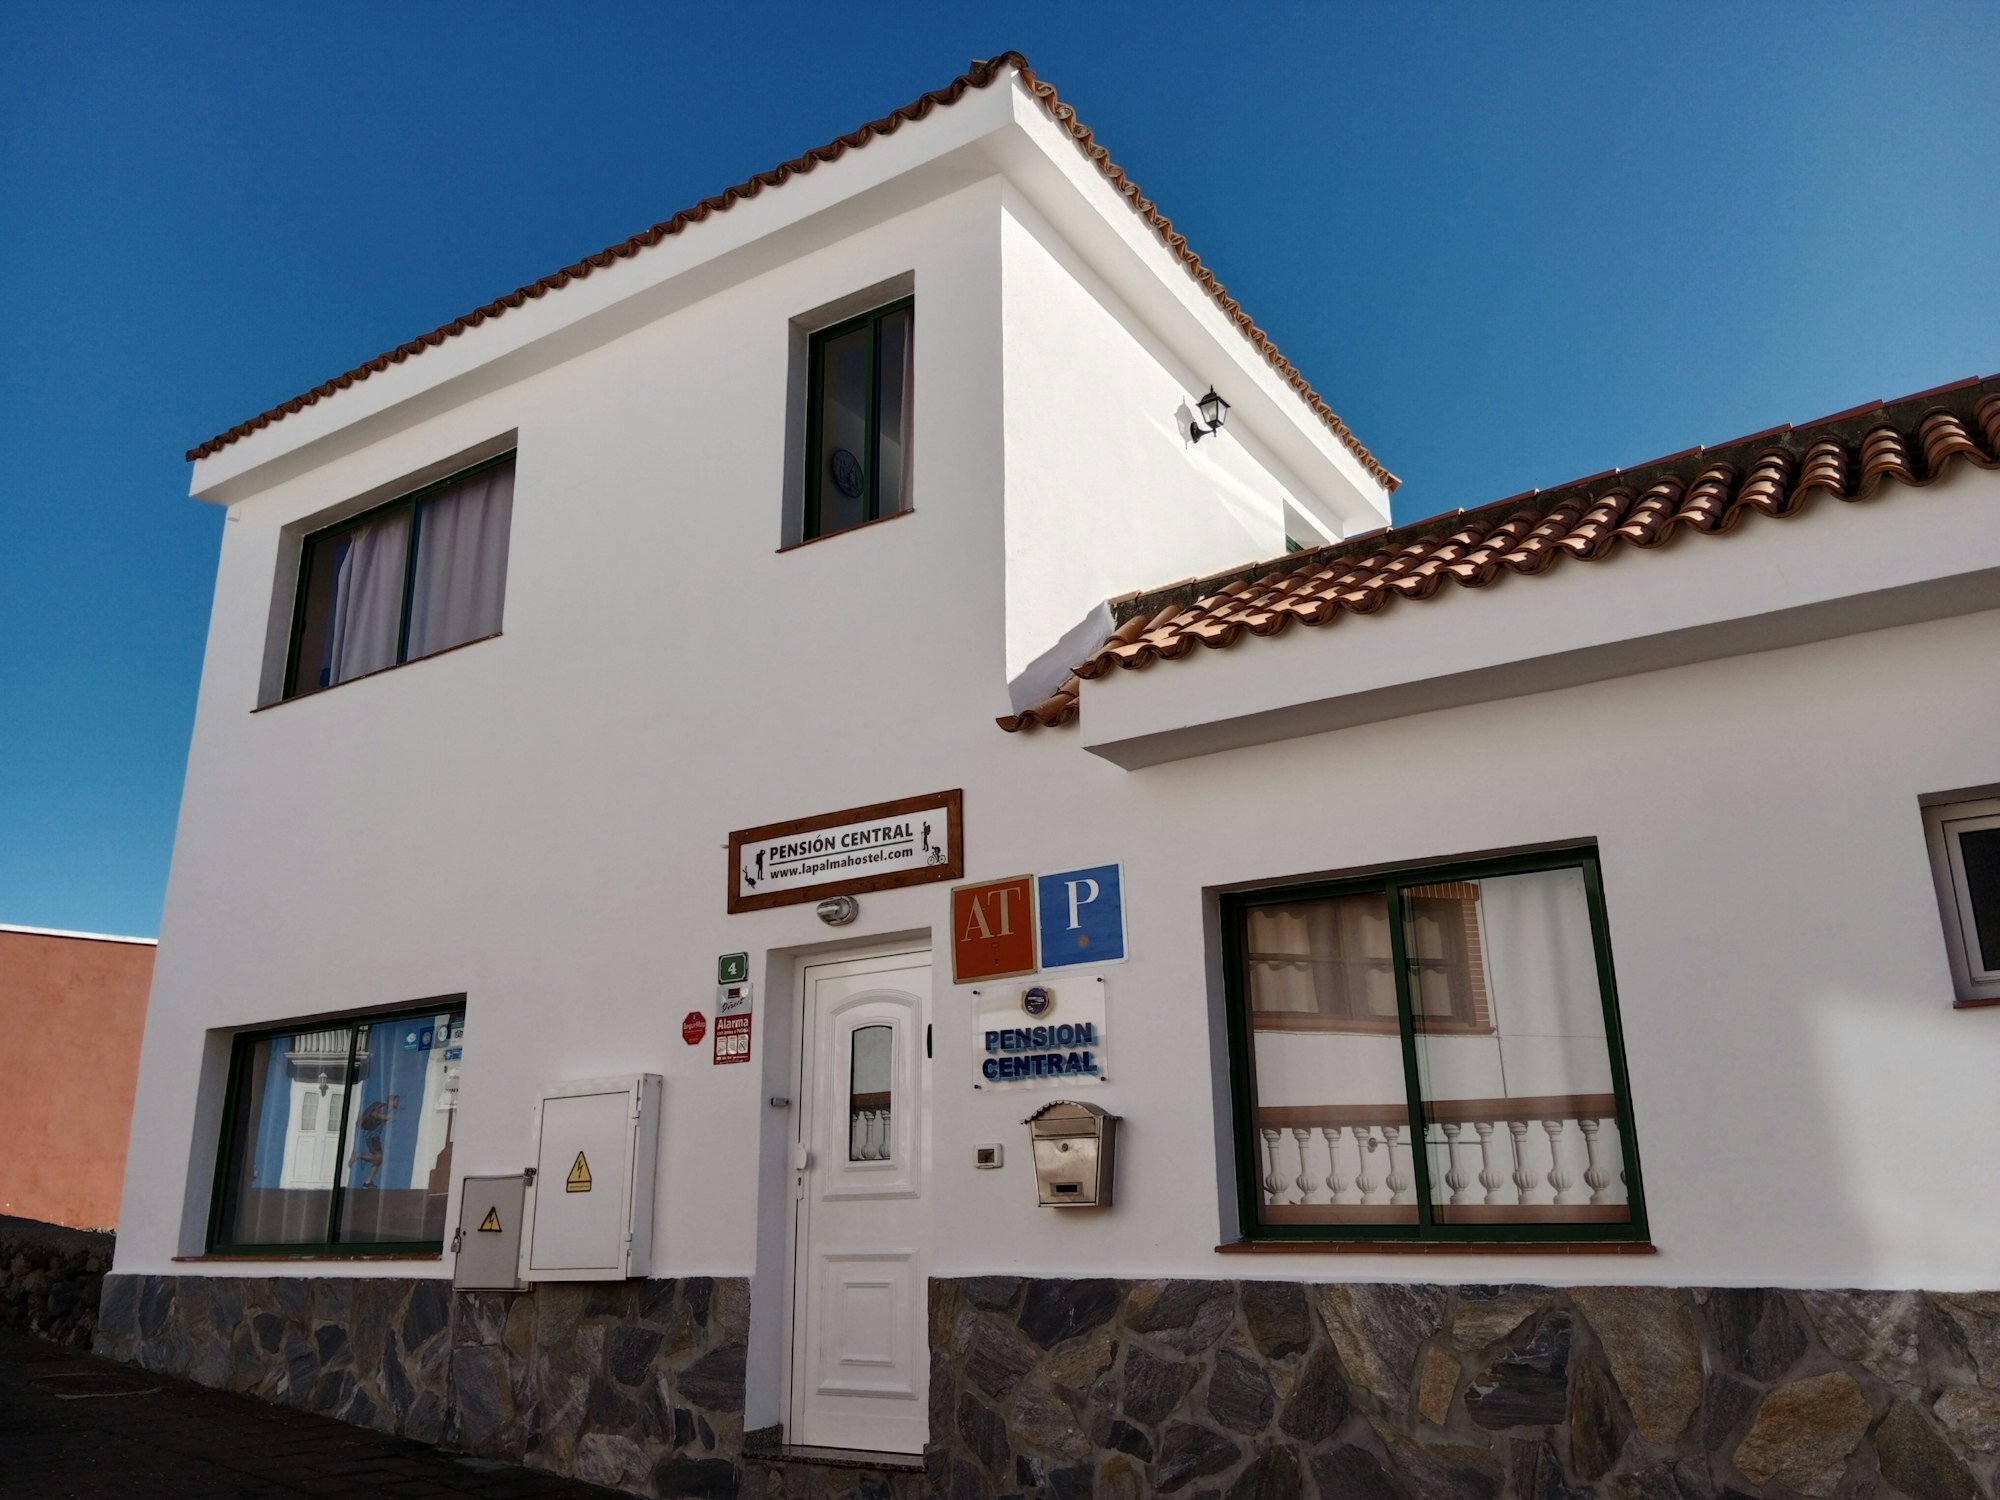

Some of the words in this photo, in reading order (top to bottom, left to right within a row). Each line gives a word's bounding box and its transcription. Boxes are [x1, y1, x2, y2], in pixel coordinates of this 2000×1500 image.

[769, 834, 836, 861] PENSIÓN
[841, 822, 914, 848] CENTRAL
[770, 847, 913, 879] www.lapalmahostel.com
[960, 886, 1021, 942] AT
[1064, 878, 1100, 931] P
[728, 962, 737, 975] 4
[717, 1017, 749, 1030] Alarma
[985, 1022, 1095, 1052] PENSION
[982, 1051, 1097, 1079] CENTRAL
